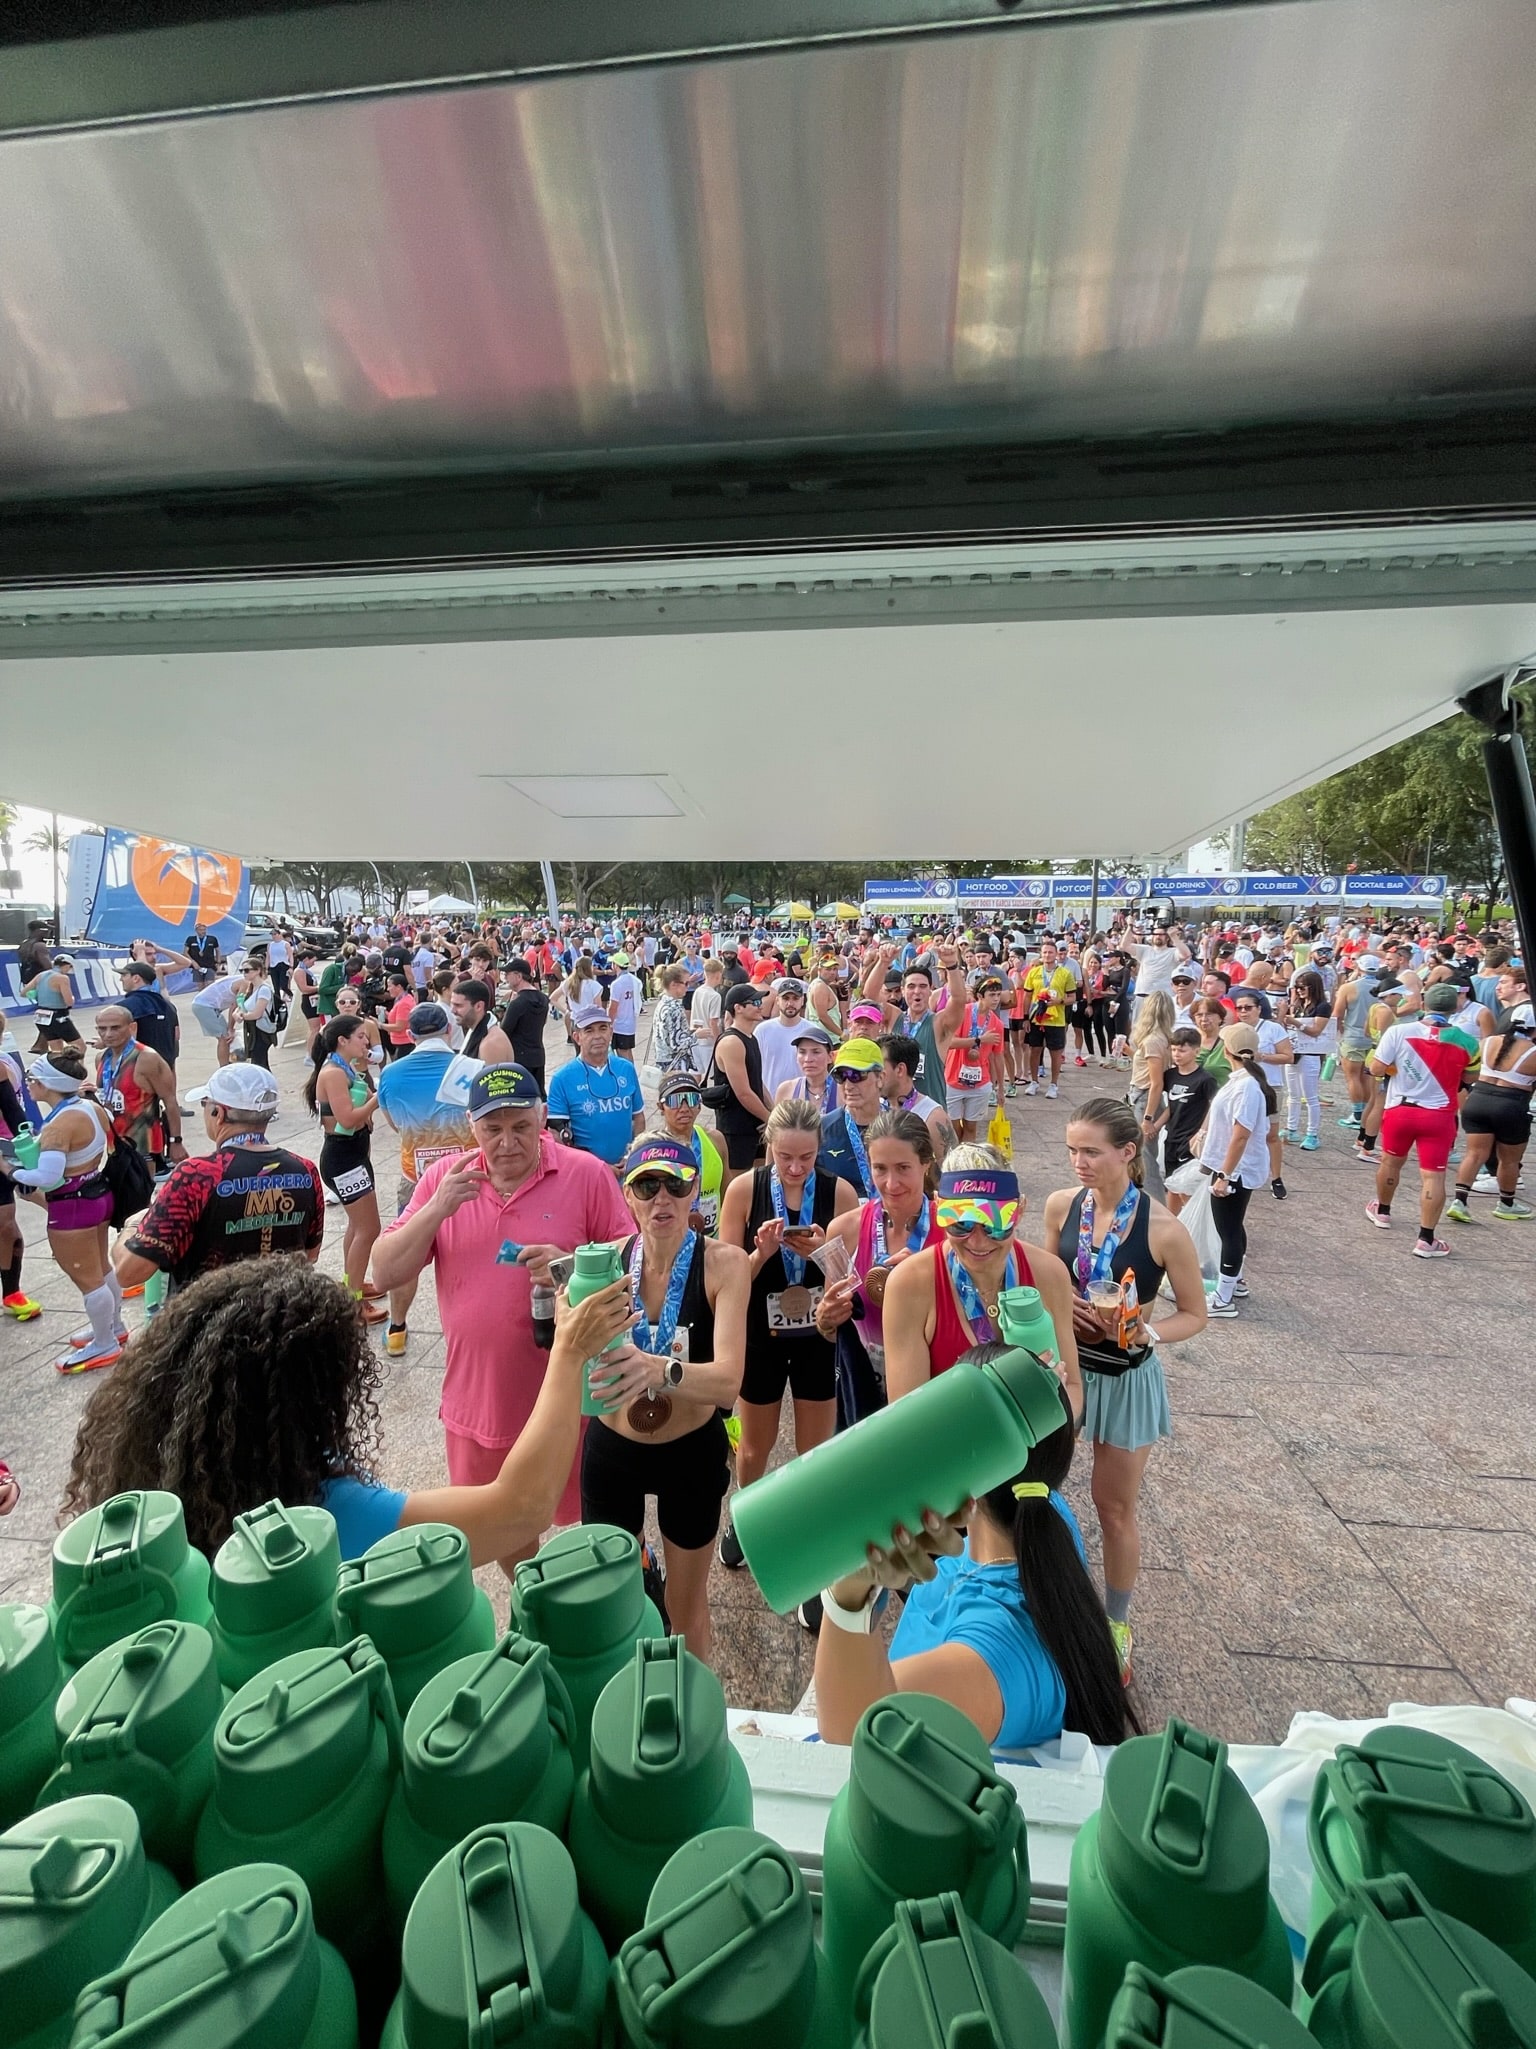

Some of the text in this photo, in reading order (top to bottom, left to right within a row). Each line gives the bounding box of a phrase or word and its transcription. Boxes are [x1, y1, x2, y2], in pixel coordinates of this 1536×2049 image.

[966, 883, 1008, 891] HOT FOOD
[1055, 884, 1107, 893] HOT COFEE
[1176, 881, 1206, 889] DRINKS
[1253, 882, 1298, 890] COLD BEER
[1350, 881, 1386, 889] COCKTAIL
[479, 1069, 524, 1086] MAX CUSHION
[598, 1095, 631, 1113] MSC
[417, 1147, 461, 1158] KIDNAPPED
[216, 1173, 313, 1198] GUERRERO
[225, 1210, 306, 1235] MEDELLIN
